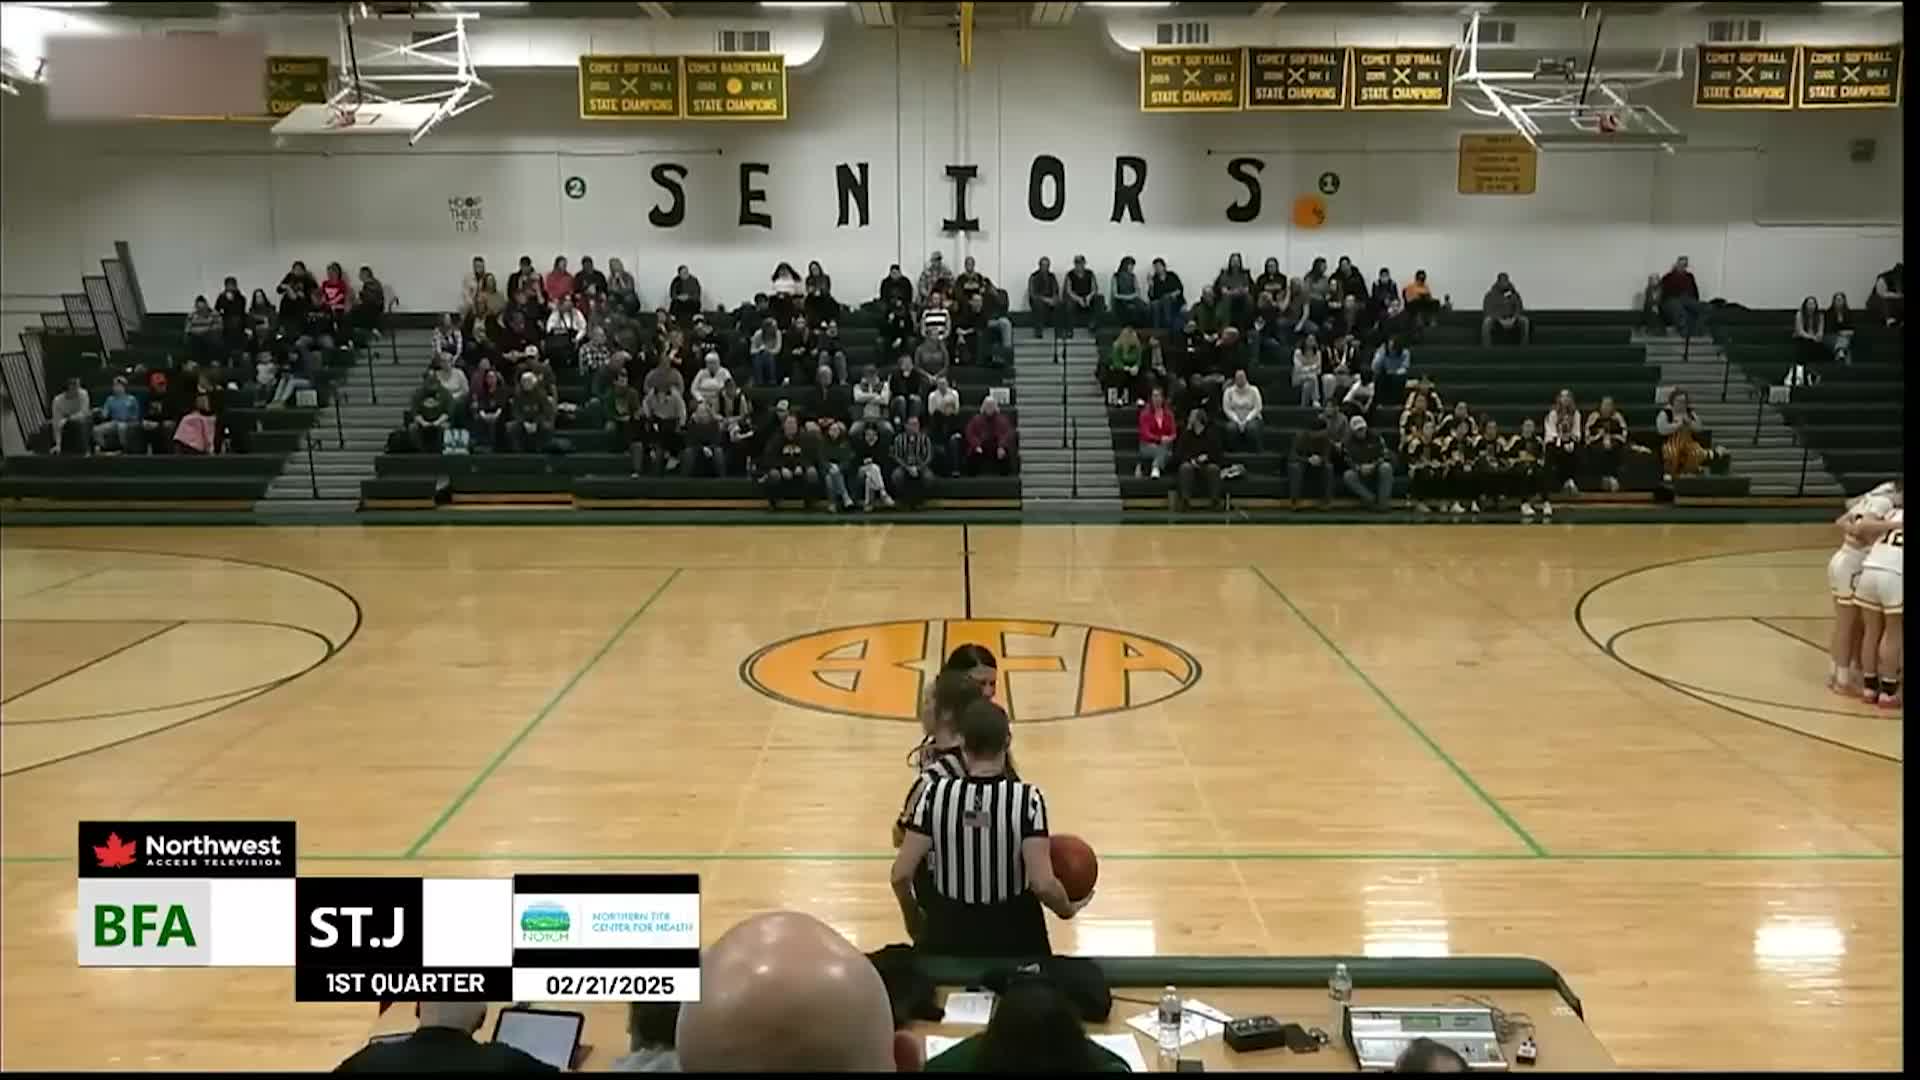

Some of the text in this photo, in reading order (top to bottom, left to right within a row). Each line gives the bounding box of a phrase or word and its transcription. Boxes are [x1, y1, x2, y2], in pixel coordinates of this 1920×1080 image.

[1151, 89, 1233, 104] STATE CHAMPIONS
[1255, 86, 1337, 100] STATE CHAMPIONS
[1360, 86, 1443, 101] STATE CHAMPIONS
[1703, 85, 1785, 99] STATE CHAMPIONS
[1808, 84, 1891, 99] STATE CHAMPIONS
[589, 98, 673, 113] STATE CHAMPIONS
[692, 98, 777, 113] STATE CHAMPIONS
[648, 154, 1266, 231] SENIORS
[456, 221, 480, 233] IT IS
